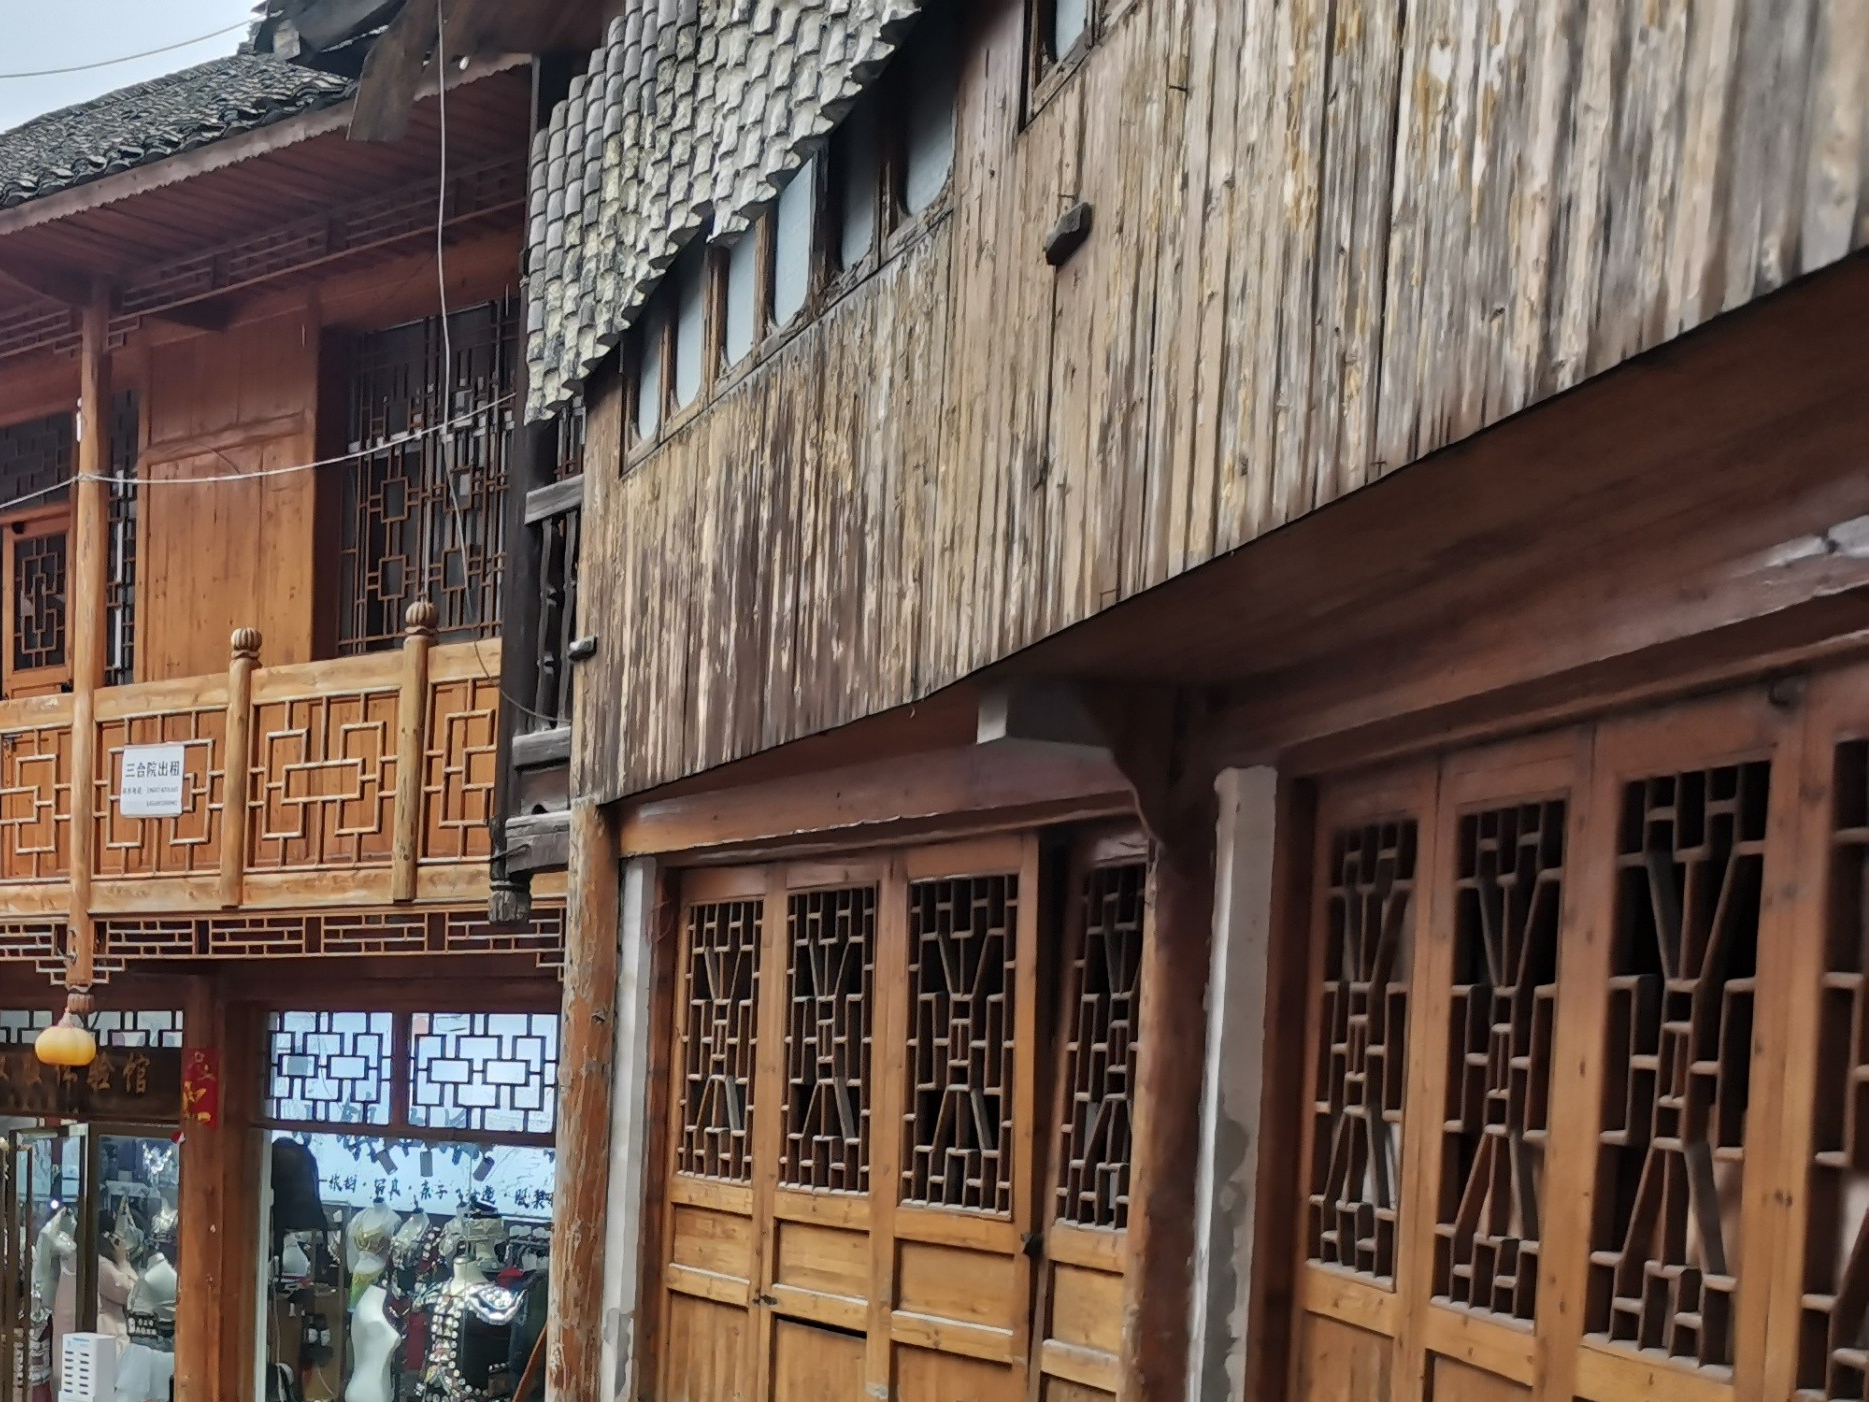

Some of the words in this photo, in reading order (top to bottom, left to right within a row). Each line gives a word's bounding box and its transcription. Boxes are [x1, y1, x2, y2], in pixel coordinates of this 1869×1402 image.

[125, 760, 180, 778] 三合院出租
